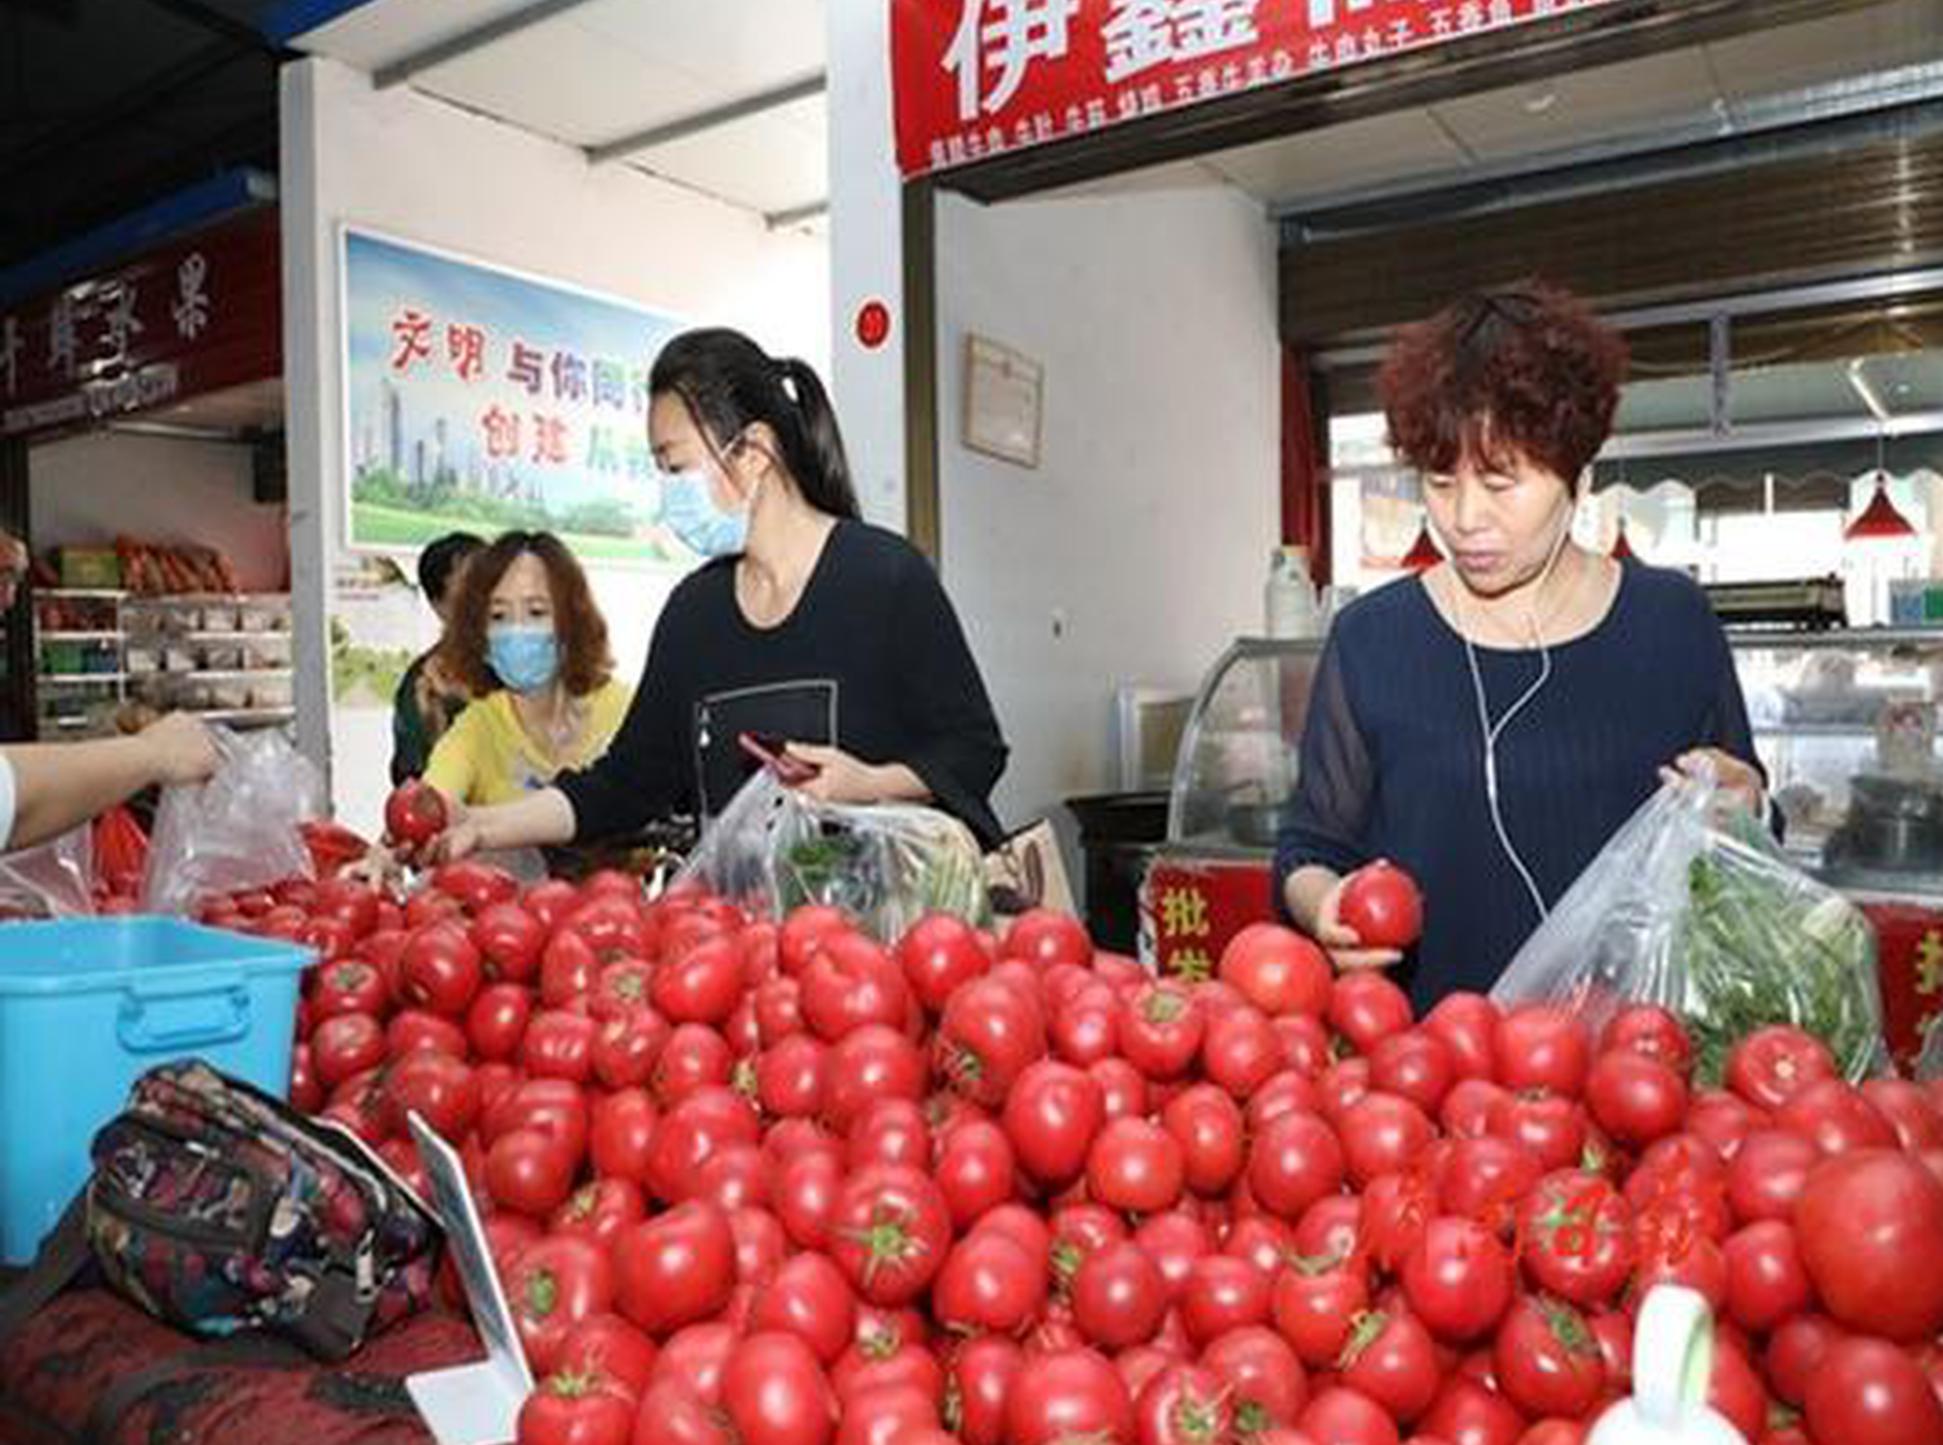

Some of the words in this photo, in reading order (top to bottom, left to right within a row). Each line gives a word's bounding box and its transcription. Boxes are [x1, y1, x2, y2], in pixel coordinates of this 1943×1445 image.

[1308, 20, 1413, 68] 牛肉丸子
[392, 310, 486, 382] 文明
[480, 402, 570, 464] 创建
